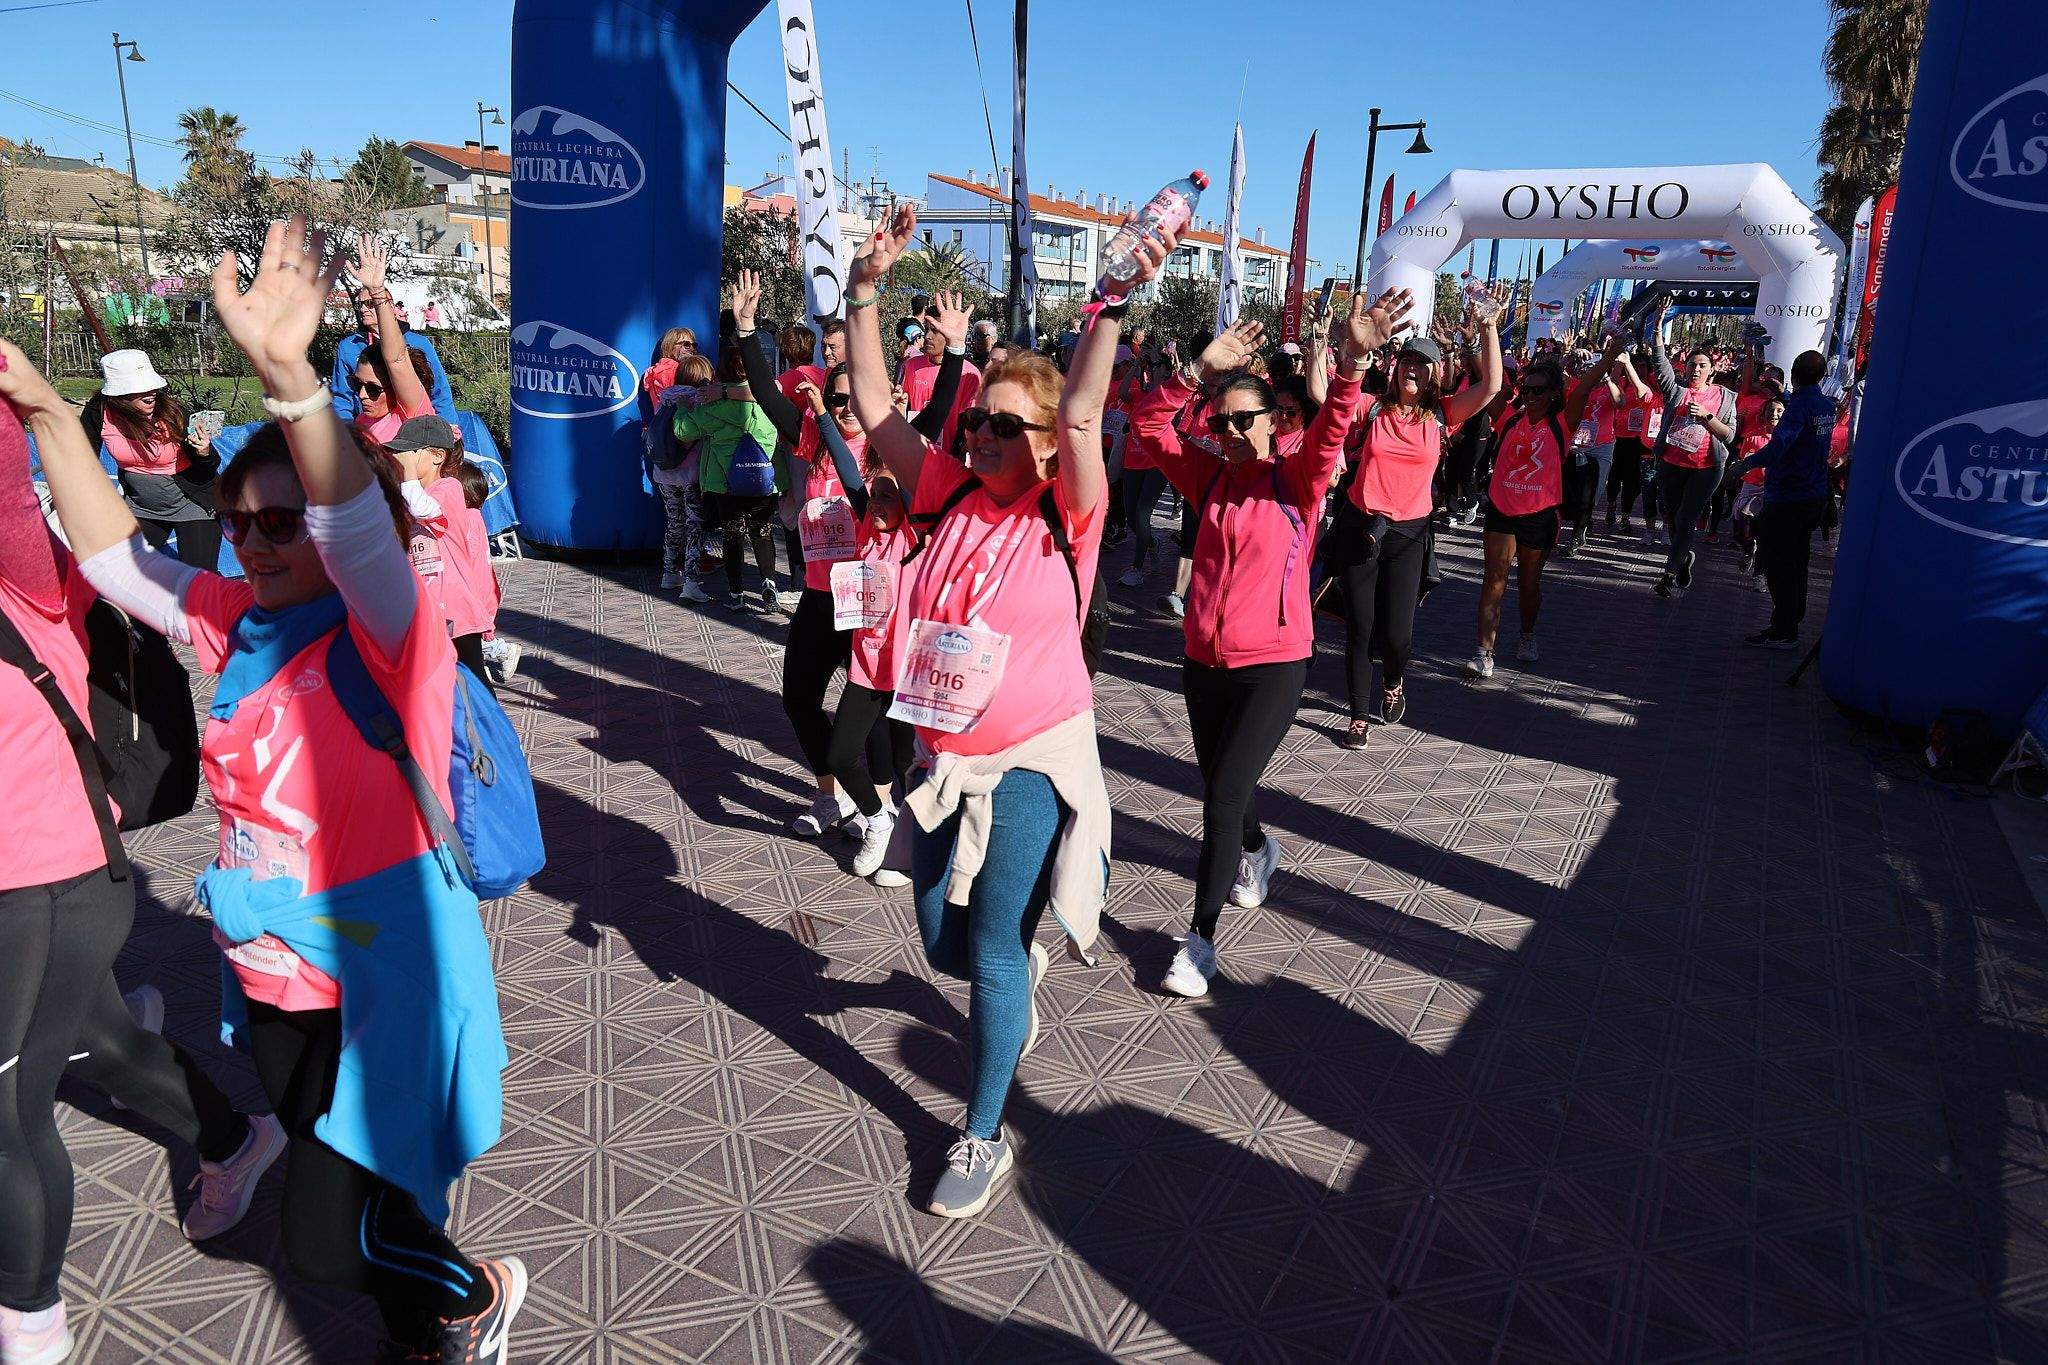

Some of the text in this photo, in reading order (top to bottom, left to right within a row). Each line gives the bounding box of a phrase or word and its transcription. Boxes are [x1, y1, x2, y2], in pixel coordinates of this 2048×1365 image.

[557, 143, 624, 159] LECHERA
[511, 156, 630, 190] STURIANA
[1501, 182, 1690, 221] OYSHO
[1398, 225, 1448, 238] OYSHO
[1743, 223, 1806, 237] OYSHO
[1669, 289, 1751, 298] VOLVO
[1765, 304, 1824, 318] OYSHO
[554, 356, 618, 371] LECHERA
[511, 364, 625, 399] STURIANA
[823, 524, 845, 536] 016
[856, 590, 876, 603] 016
[928, 669, 965, 690] 016
[900, 706, 928, 720] OYSHO
